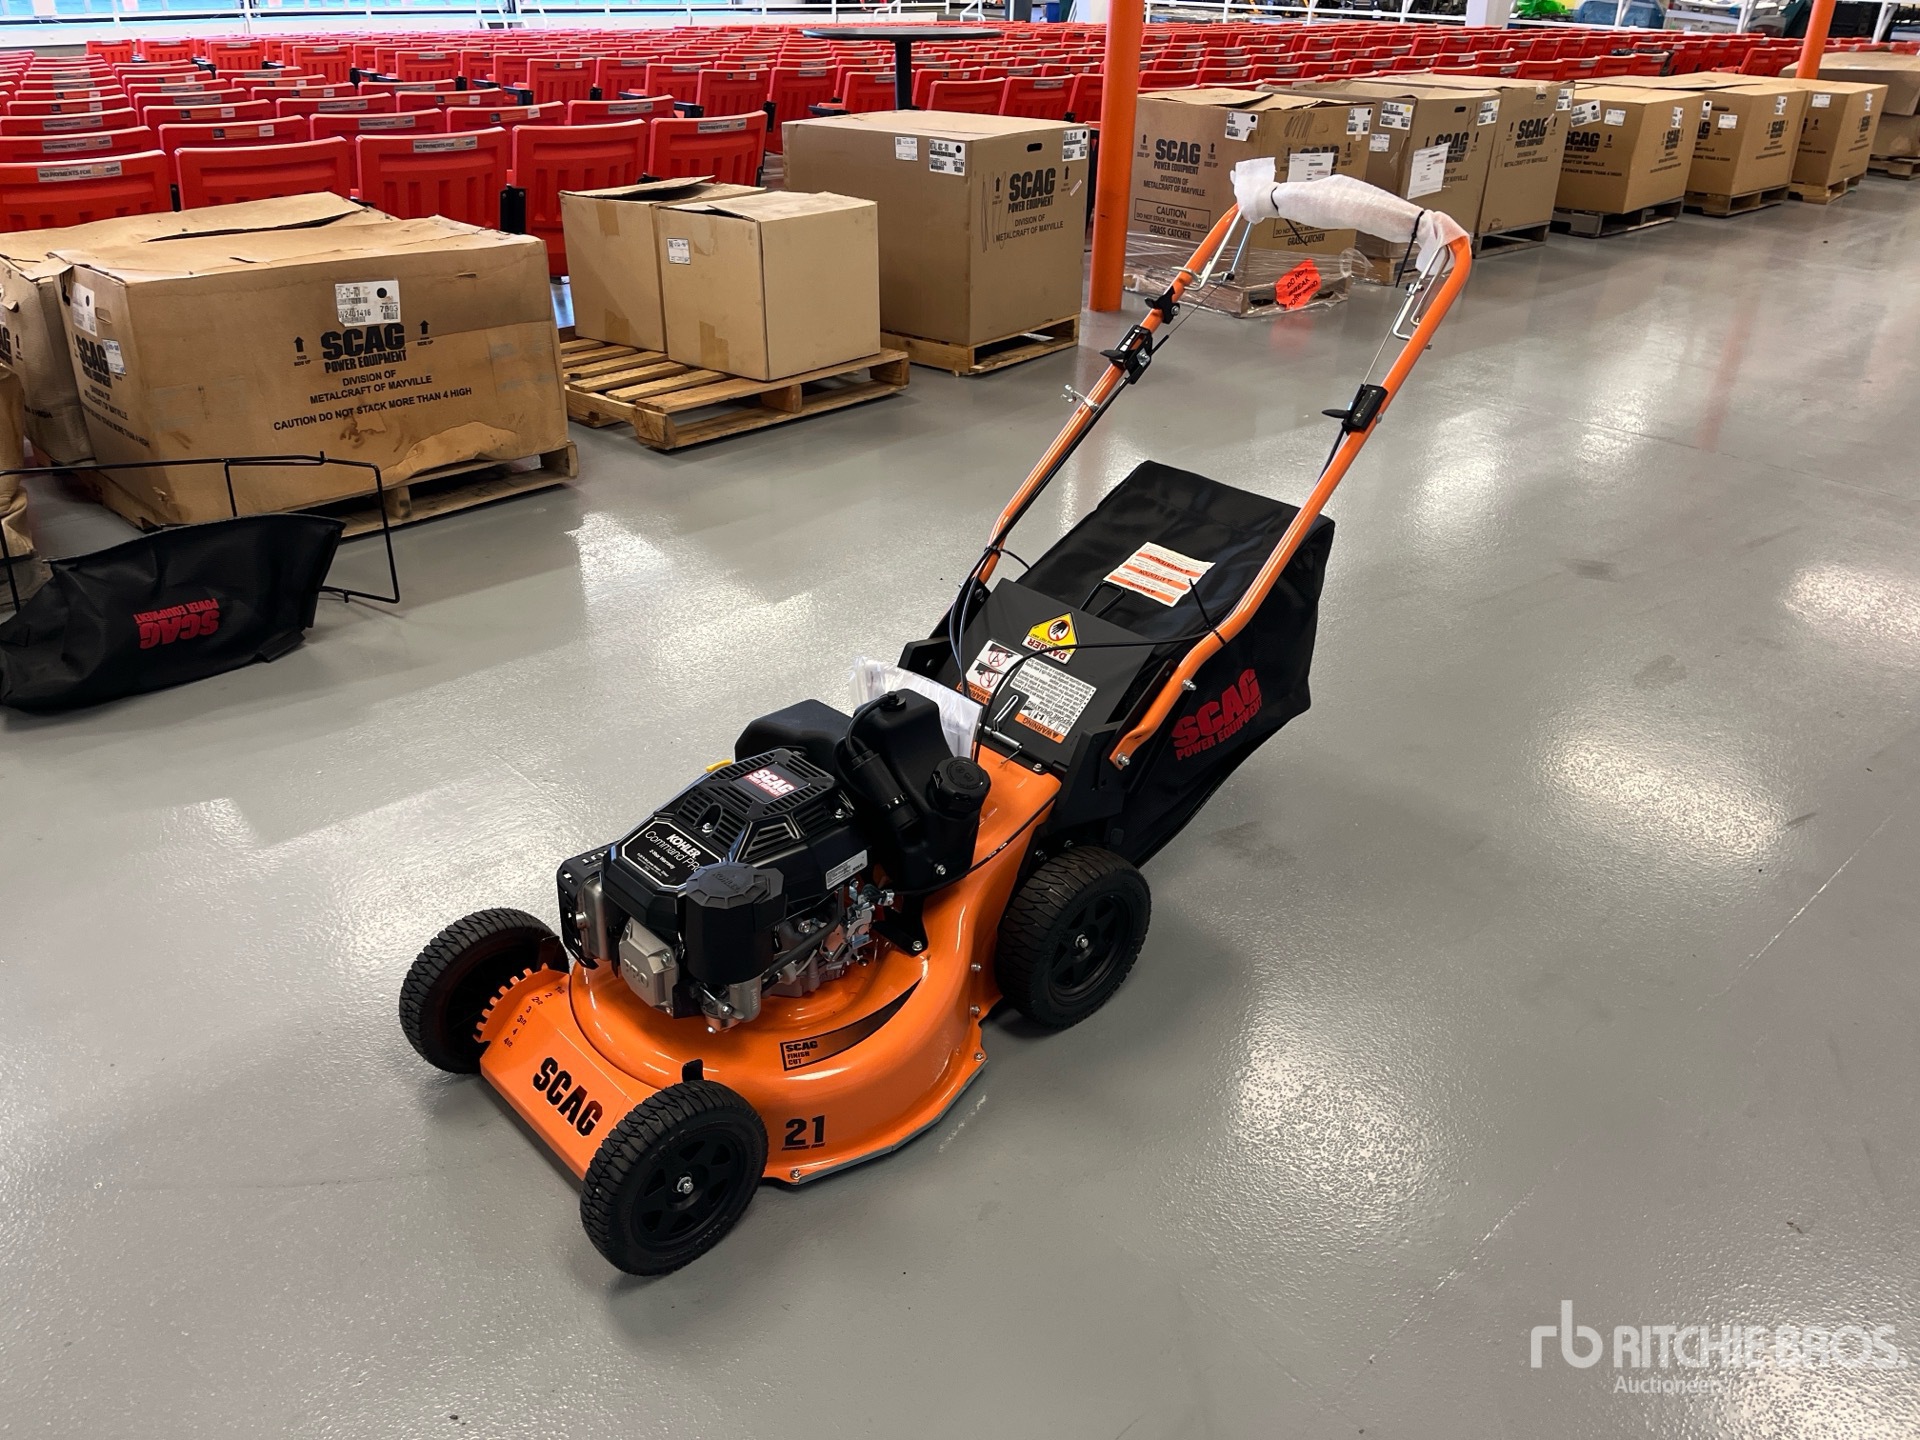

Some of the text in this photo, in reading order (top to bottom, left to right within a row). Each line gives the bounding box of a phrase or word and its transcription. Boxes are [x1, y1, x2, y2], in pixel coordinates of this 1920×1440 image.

[1155, 139, 1201, 165] SCAG
[1154, 160, 1199, 175] POWER EQUIPMENT
[1160, 175, 1181, 184] DIVISION
[1009, 168, 1056, 201] SCAG
[1144, 180, 1173, 191] METALCRAFT
[1008, 200, 1025, 213] POWER
[1156, 206, 1187, 219] CAUTION
[995, 221, 1063, 242] METALCRAFT OF MAYVILLE
[1015, 214, 1046, 226] DIVISION OF
[1150, 225, 1191, 239] GRASS CATCHER
[321, 323, 405, 360] SCAG
[324, 349, 407, 374] POWER EQUIPMENT
[310, 375, 432, 404] METALCRAFT OF MAYVILLE
[342, 370, 396, 386] DIVISION OF
[274, 387, 472, 430] CAUTION DO NOT STACK MORE THAN 4 HIGH
[133, 598, 219, 624] POWER EQUIPMENT
[139, 610, 220, 649] SCAG
[1027, 638, 1068, 660] DAGER
[1171, 669, 1260, 747] SCAG
[1022, 716, 1054, 738] WARNING
[1176, 694, 1262, 760] POWER EQUIPMENT
[752, 769, 795, 795] SCAG
[644, 830, 684, 861] Command
[666, 833, 701, 858] KOHLER
[785, 1041, 818, 1052] SCAG
[787, 1051, 810, 1059] FINISH
[533, 1057, 603, 1136] SCAG
[785, 1115, 825, 1146] 21
